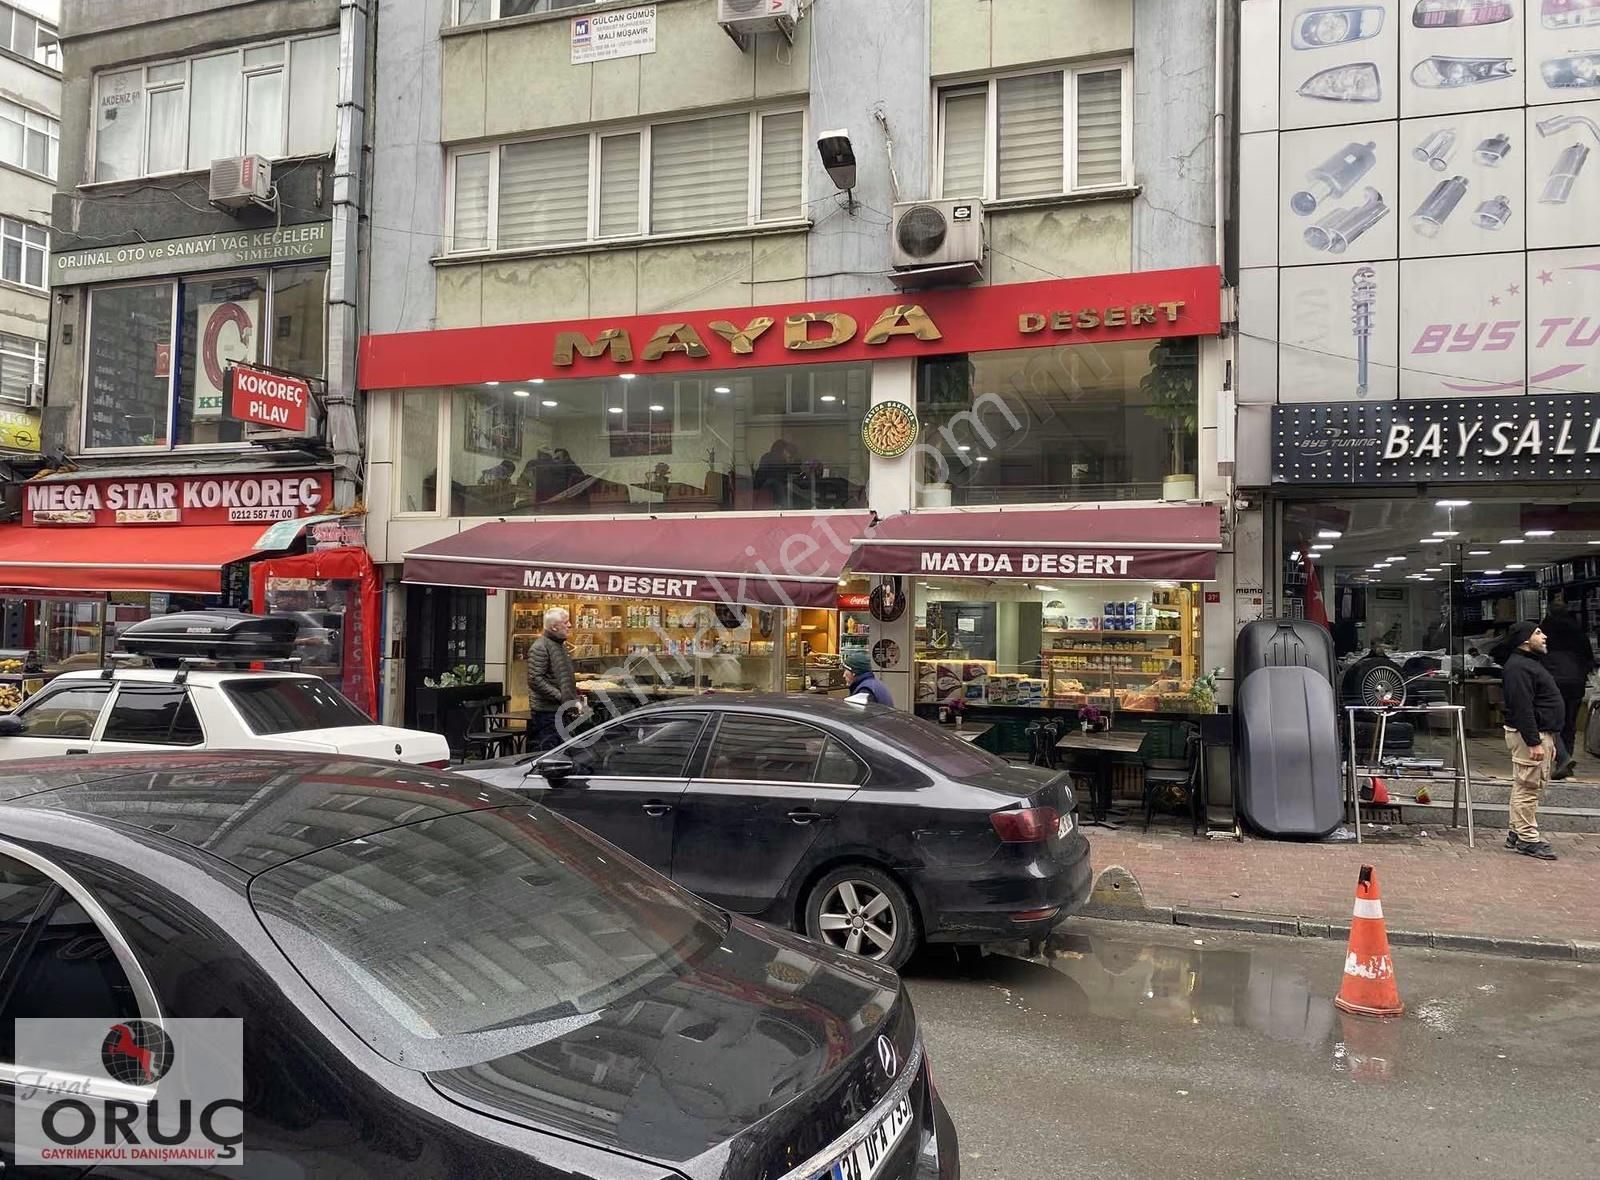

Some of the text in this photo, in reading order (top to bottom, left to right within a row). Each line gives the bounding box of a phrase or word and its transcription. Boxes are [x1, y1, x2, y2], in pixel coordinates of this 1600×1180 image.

[58, 251, 112, 269] ORJİNAL
[117, 247, 145, 262] OTO
[149, 248, 163, 259] ve
[167, 235, 216, 257] SANAYİ
[235, 243, 313, 262] SIMERING
[1018, 300, 1186, 334] DESERT
[552, 303, 943, 367] MAYDA
[1411, 320, 1521, 354] BYS
[238, 373, 303, 407] KOKOREÇ
[250, 401, 288, 423] PİLAV
[865, 402, 915, 423] MAYDA BAKLAVA
[1300, 438, 1377, 448] BYS TUNING
[27, 477, 321, 513] MEGA STAR KOKOREÇ
[231, 508, 293, 520] 0212 587 47 00
[921, 552, 1134, 575] MAYDA DESERT
[523, 570, 698, 597] MAYDA DESERT
